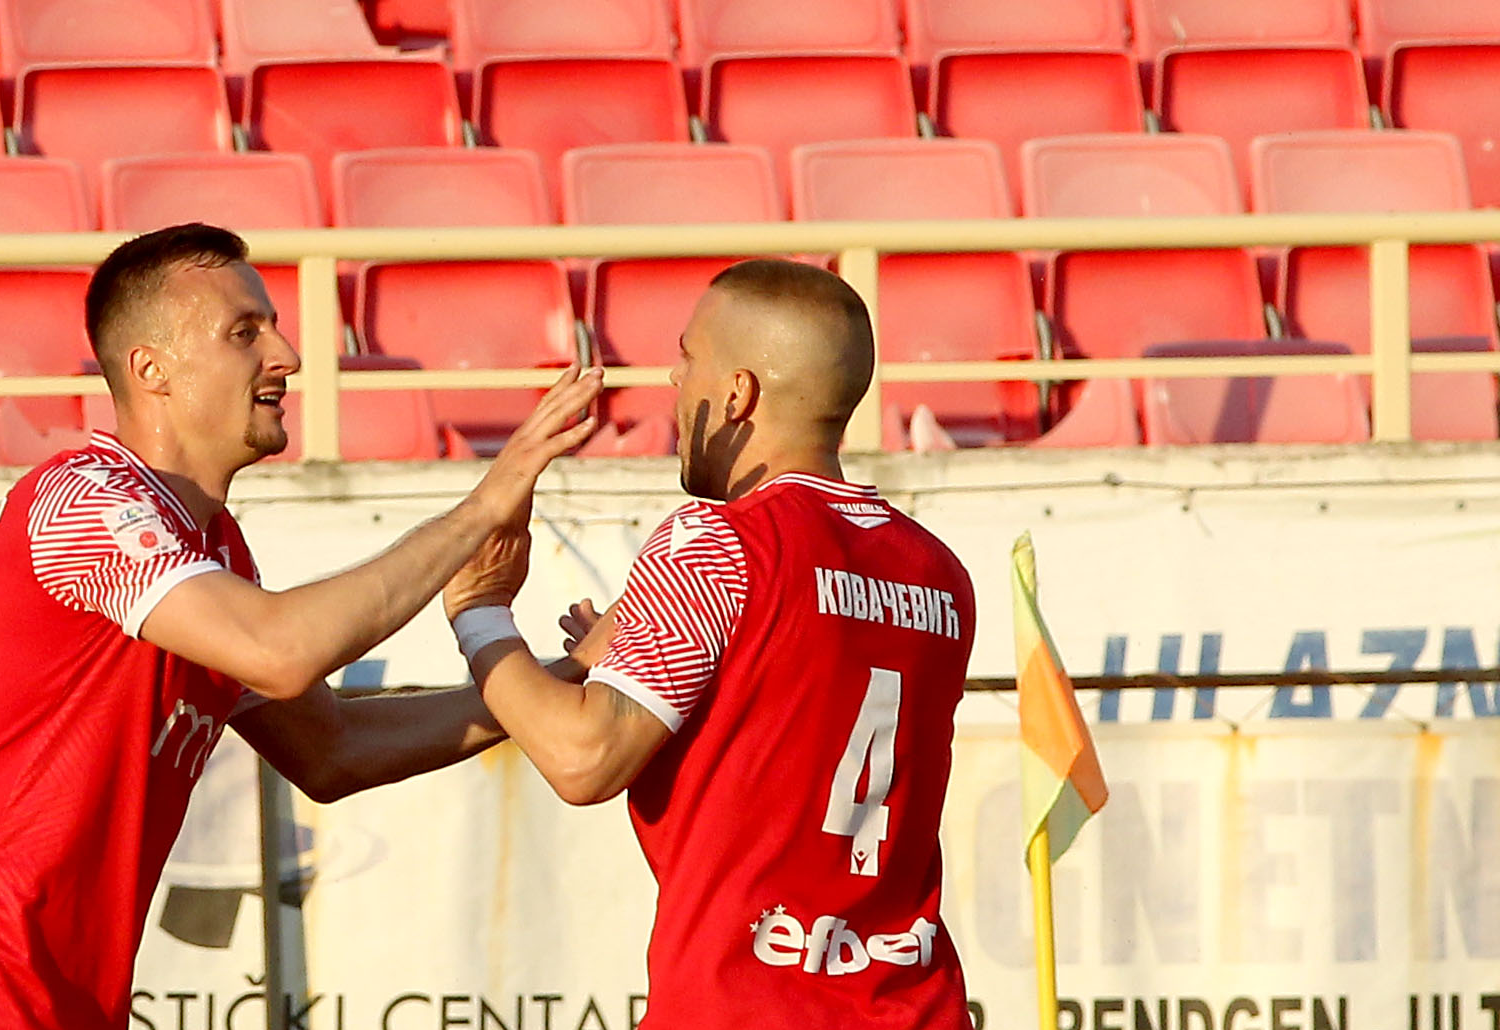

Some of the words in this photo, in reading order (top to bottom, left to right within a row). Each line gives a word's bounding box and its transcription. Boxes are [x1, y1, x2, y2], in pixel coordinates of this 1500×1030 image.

[814, 566, 961, 641] КОВАЧЕВИЋ
[822, 667, 902, 876] 4
[750, 904, 938, 977] efbet
